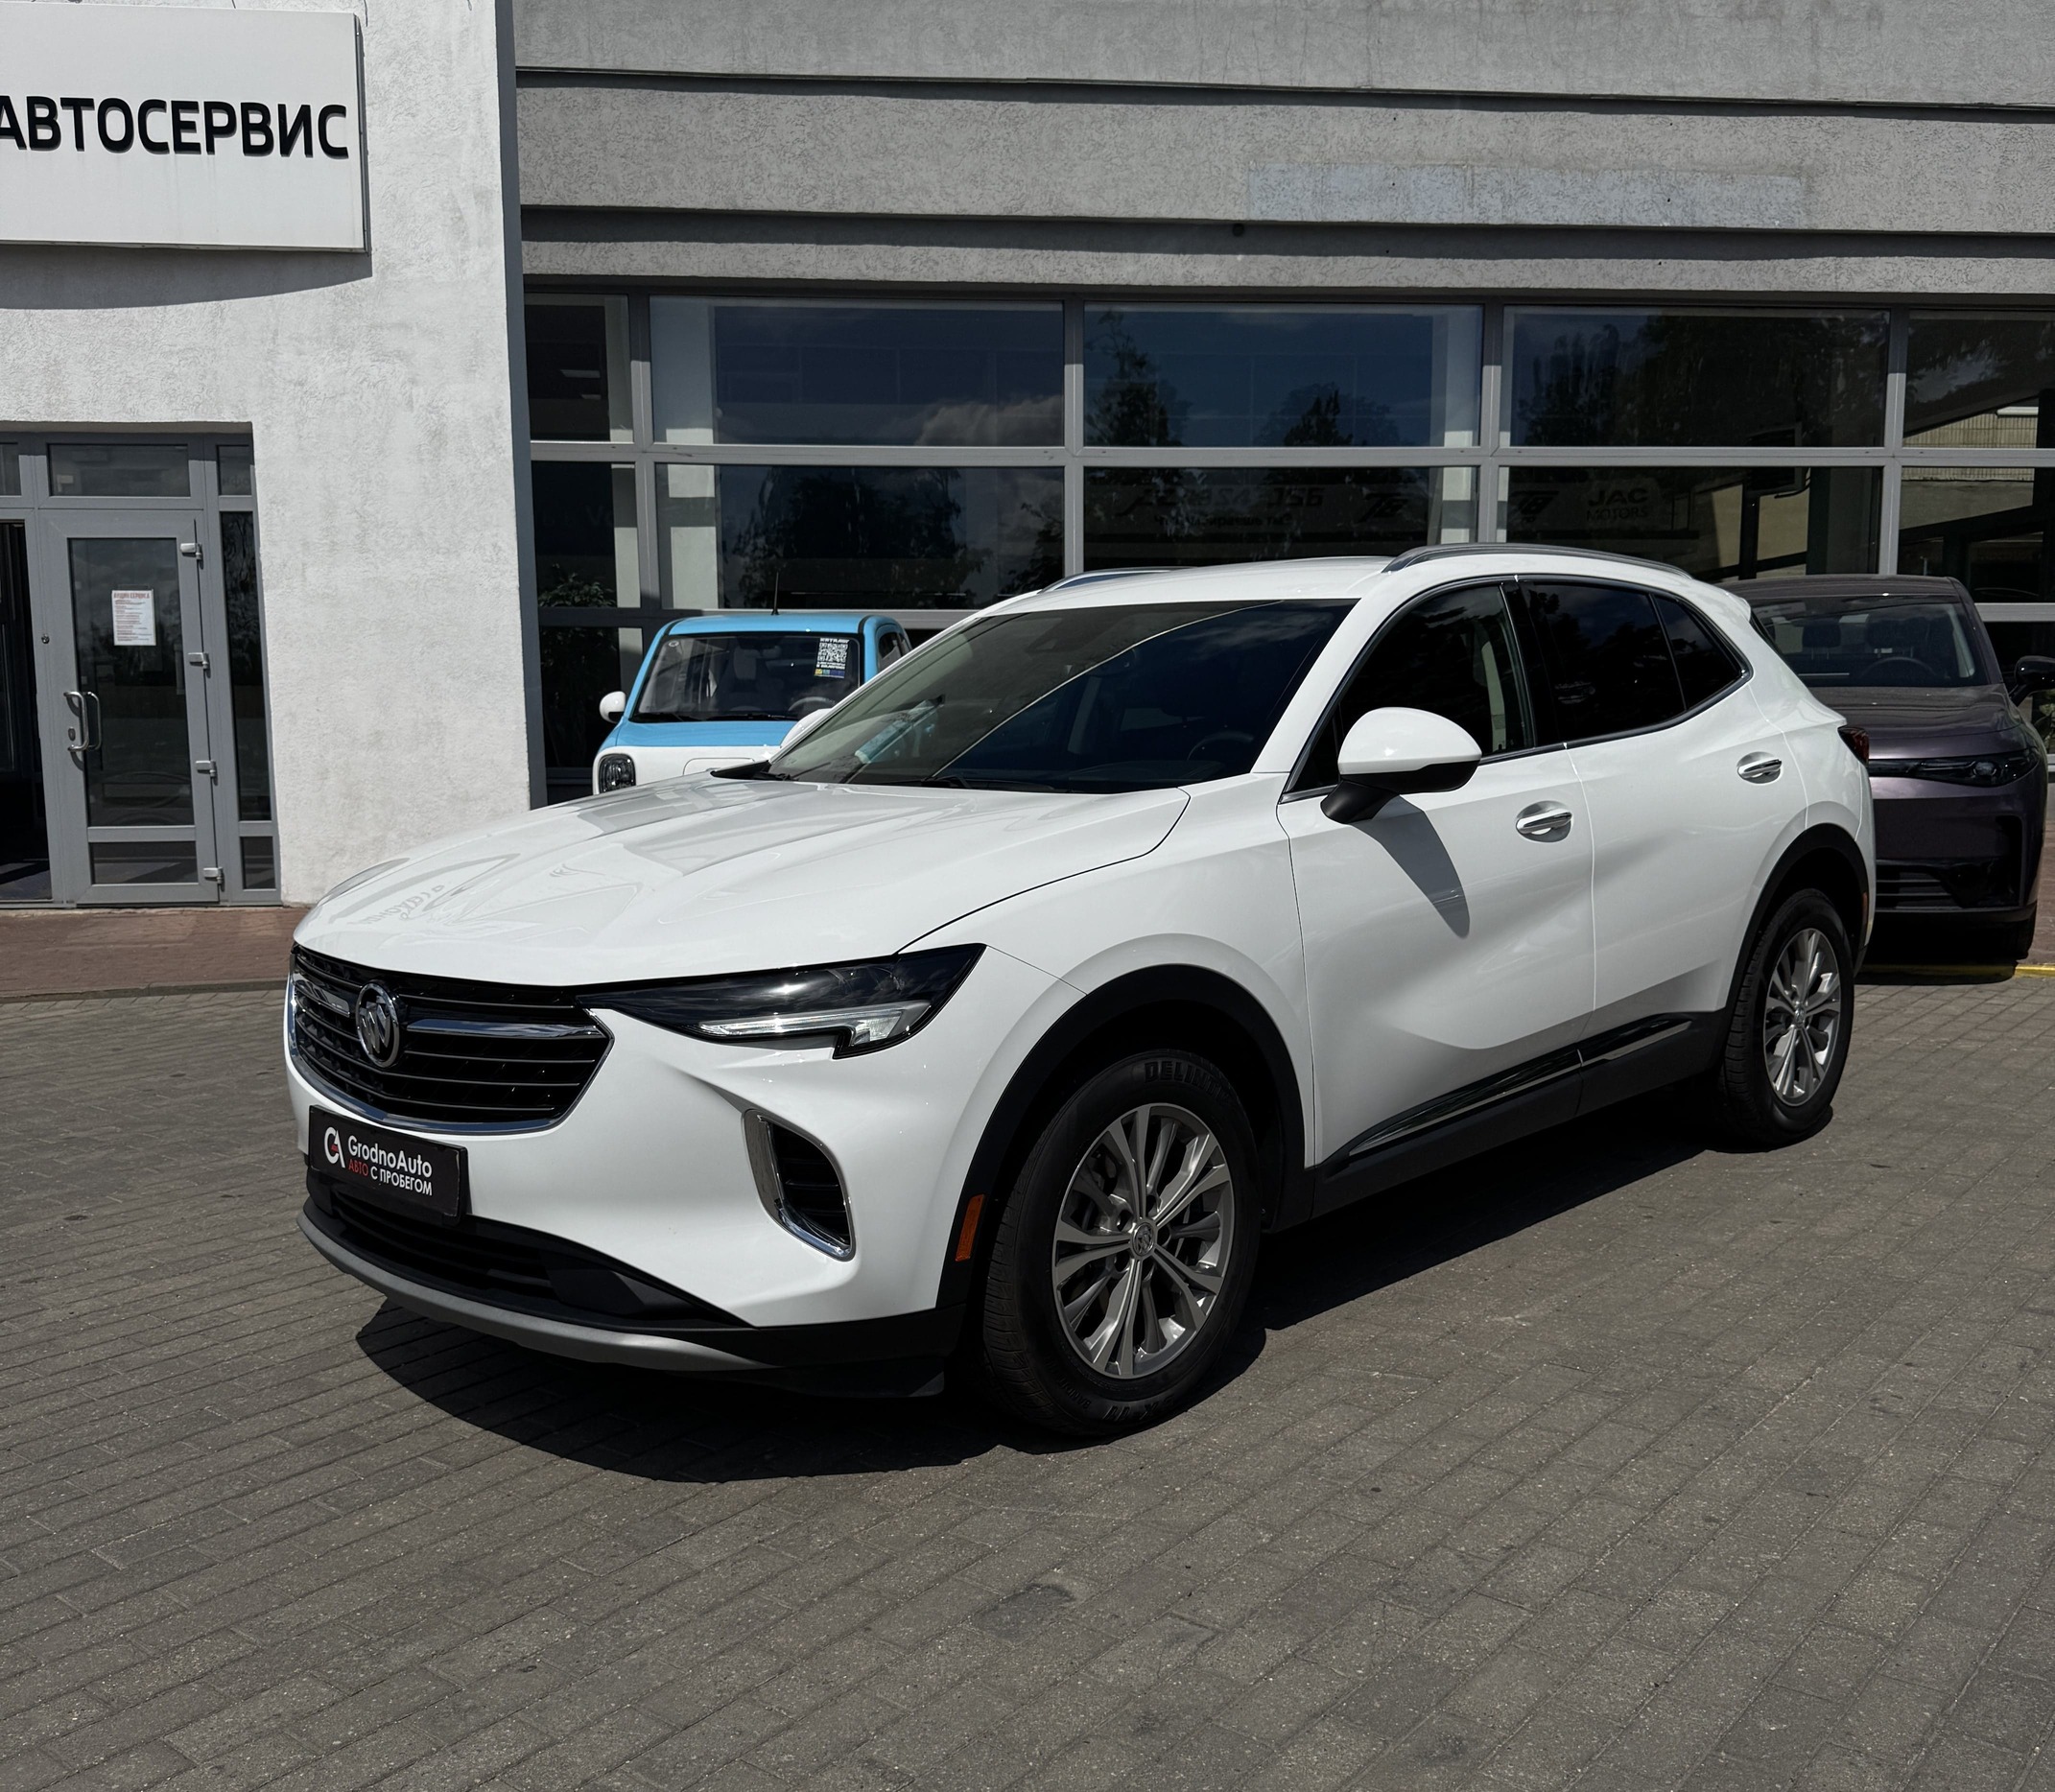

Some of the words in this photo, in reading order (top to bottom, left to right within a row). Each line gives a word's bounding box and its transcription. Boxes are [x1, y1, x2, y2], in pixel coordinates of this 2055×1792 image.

[0, 95, 349, 159] АВТОСЕРВИС
[1586, 507, 1649, 522] MOTORS
[1588, 488, 1648, 507] JAC
[348, 1135, 433, 1178] GrodnoAuto
[348, 1159, 369, 1177] АВТО
[370, 1166, 379, 1180] С
[380, 1168, 433, 1197] ПРОБЕГОМ
